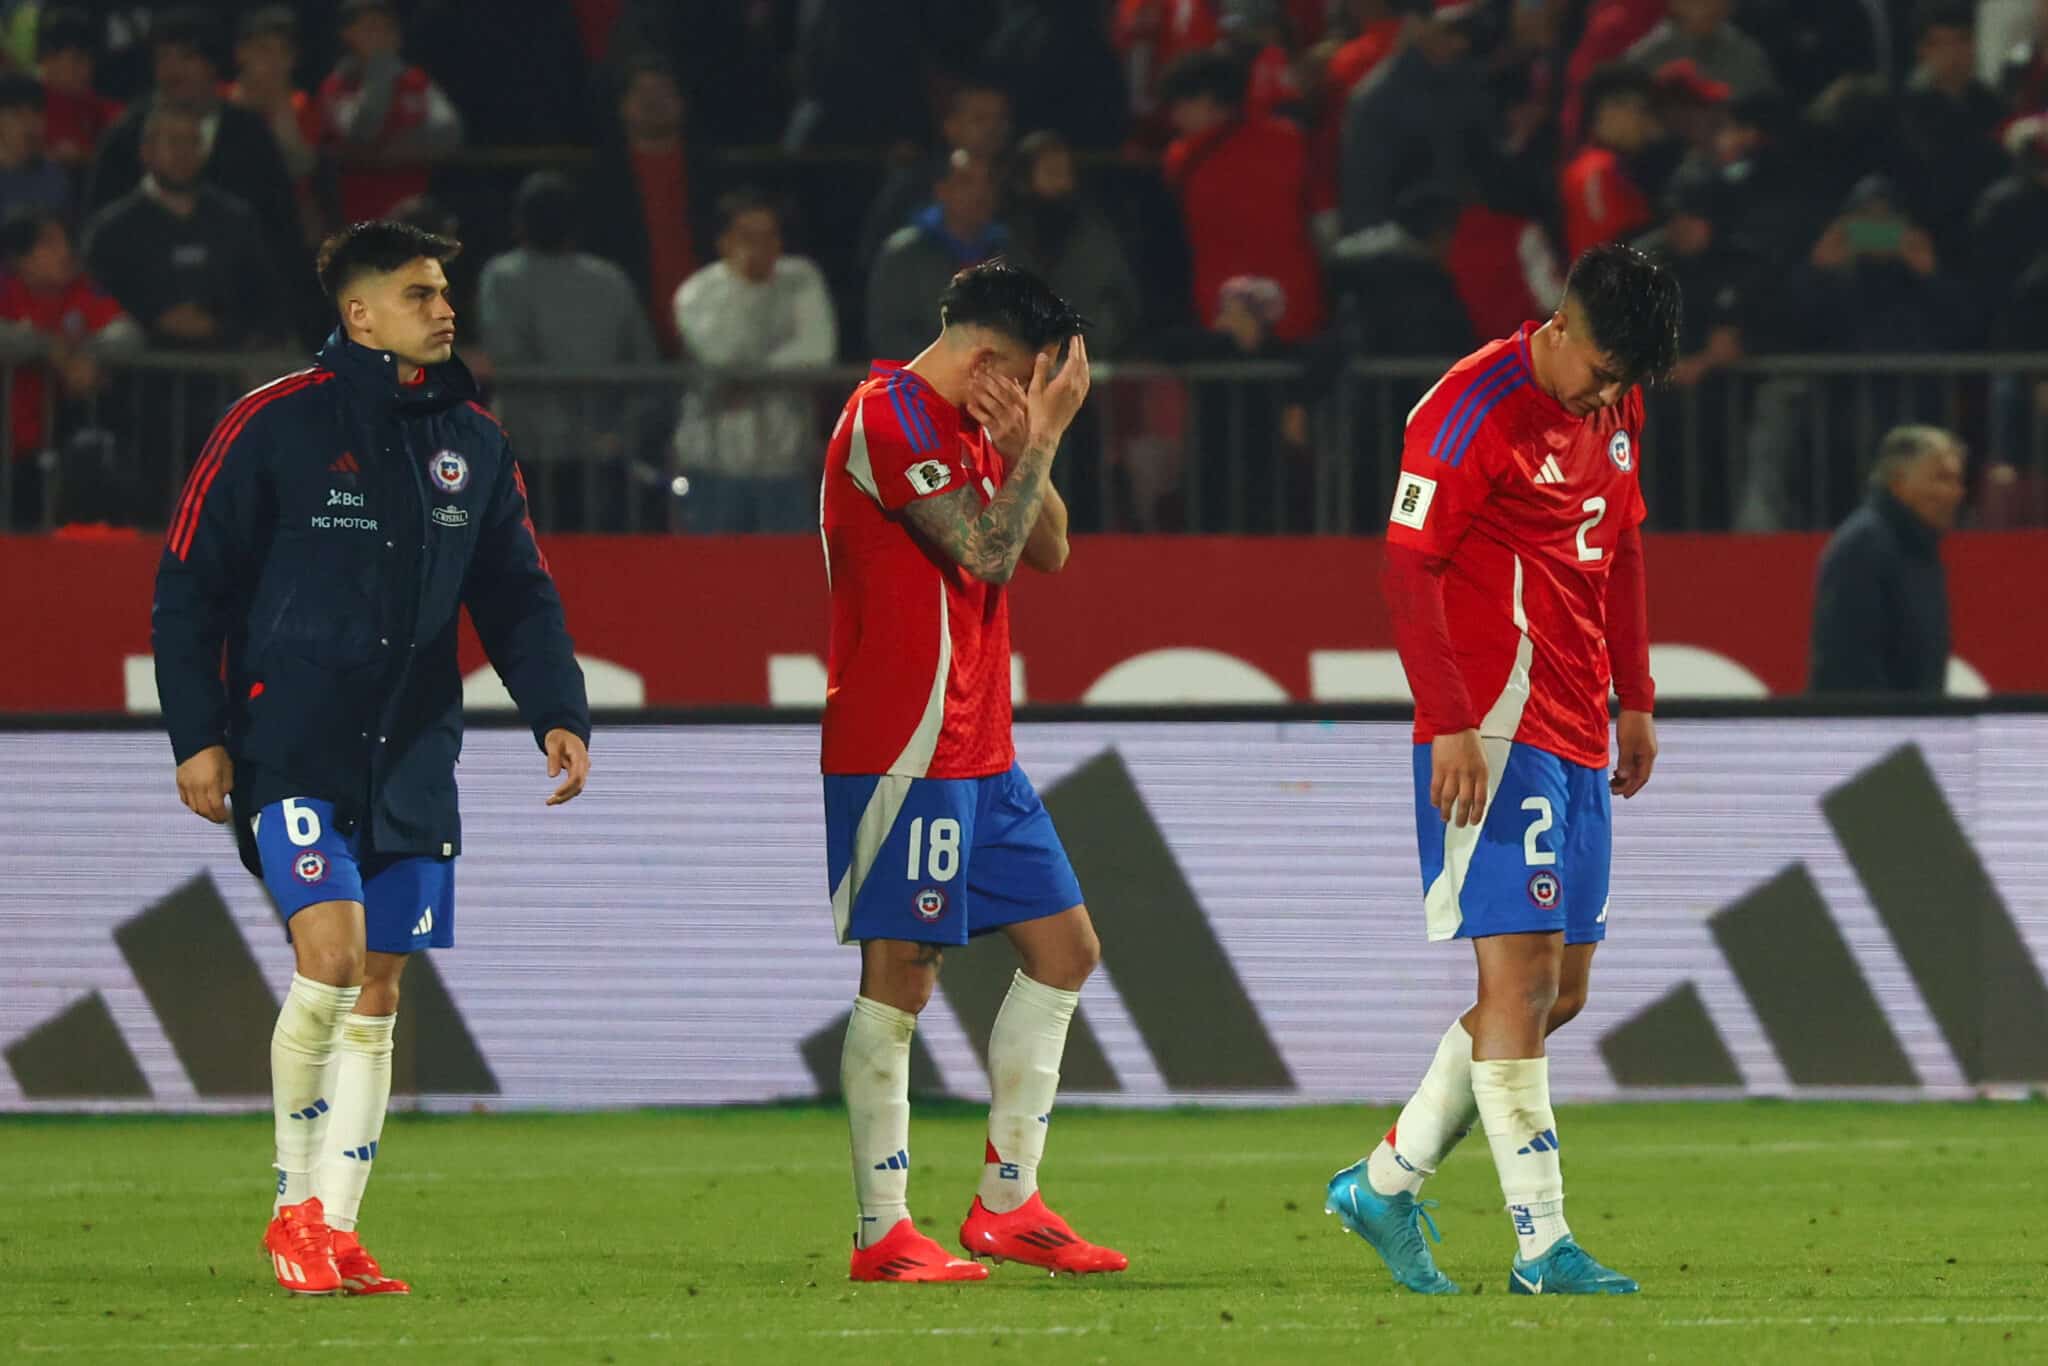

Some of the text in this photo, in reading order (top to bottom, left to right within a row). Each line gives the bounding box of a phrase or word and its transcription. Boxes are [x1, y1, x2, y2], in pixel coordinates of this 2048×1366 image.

[311, 516, 379, 531] MG MOTOR
[342, 491, 365, 507] Bci
[1575, 496, 1607, 562] 2
[282, 796, 321, 847] 6
[907, 816, 961, 882] 18
[1520, 796, 1556, 866] 2
